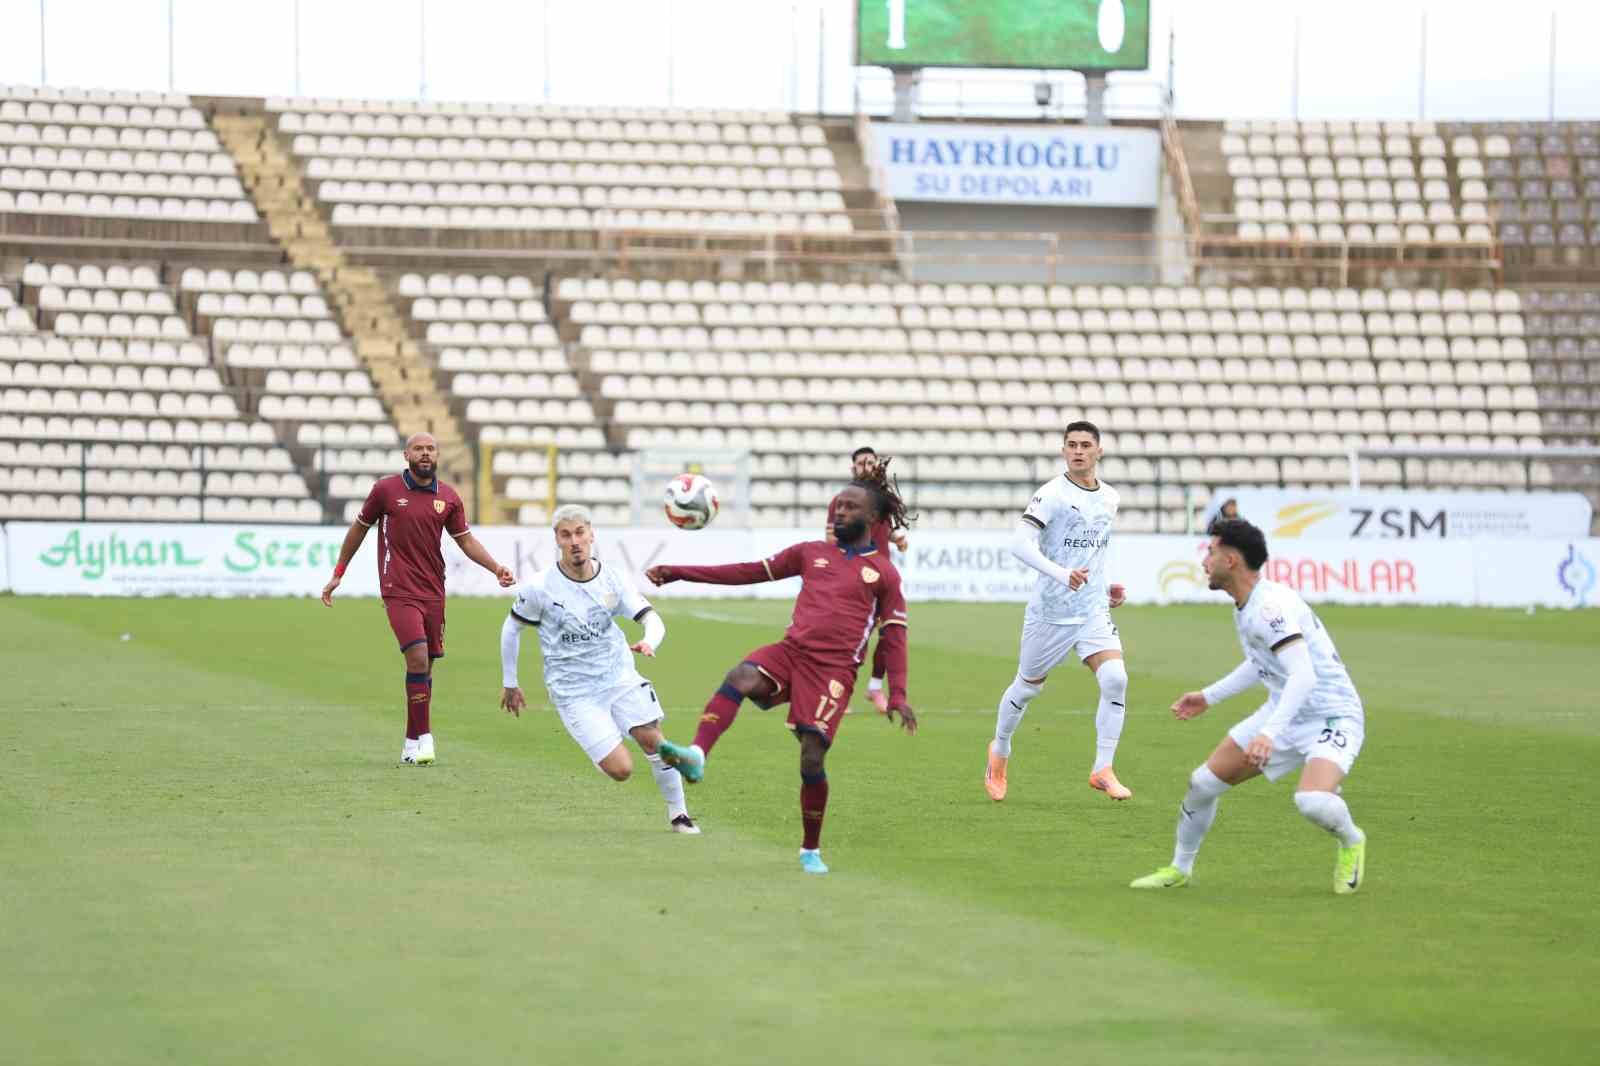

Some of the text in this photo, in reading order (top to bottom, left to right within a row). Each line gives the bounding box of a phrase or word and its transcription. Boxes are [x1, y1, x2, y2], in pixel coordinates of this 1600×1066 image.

[886, 0, 1125, 53] 1 0
[889, 134, 1120, 170] HAYRİOĞLU
[914, 173, 1092, 196] SU DEPOLARI
[1349, 508, 1447, 538] ZSM
[38, 529, 205, 580] Ayhan
[815, 695, 839, 722] 17
[1317, 728, 1347, 748] 35
